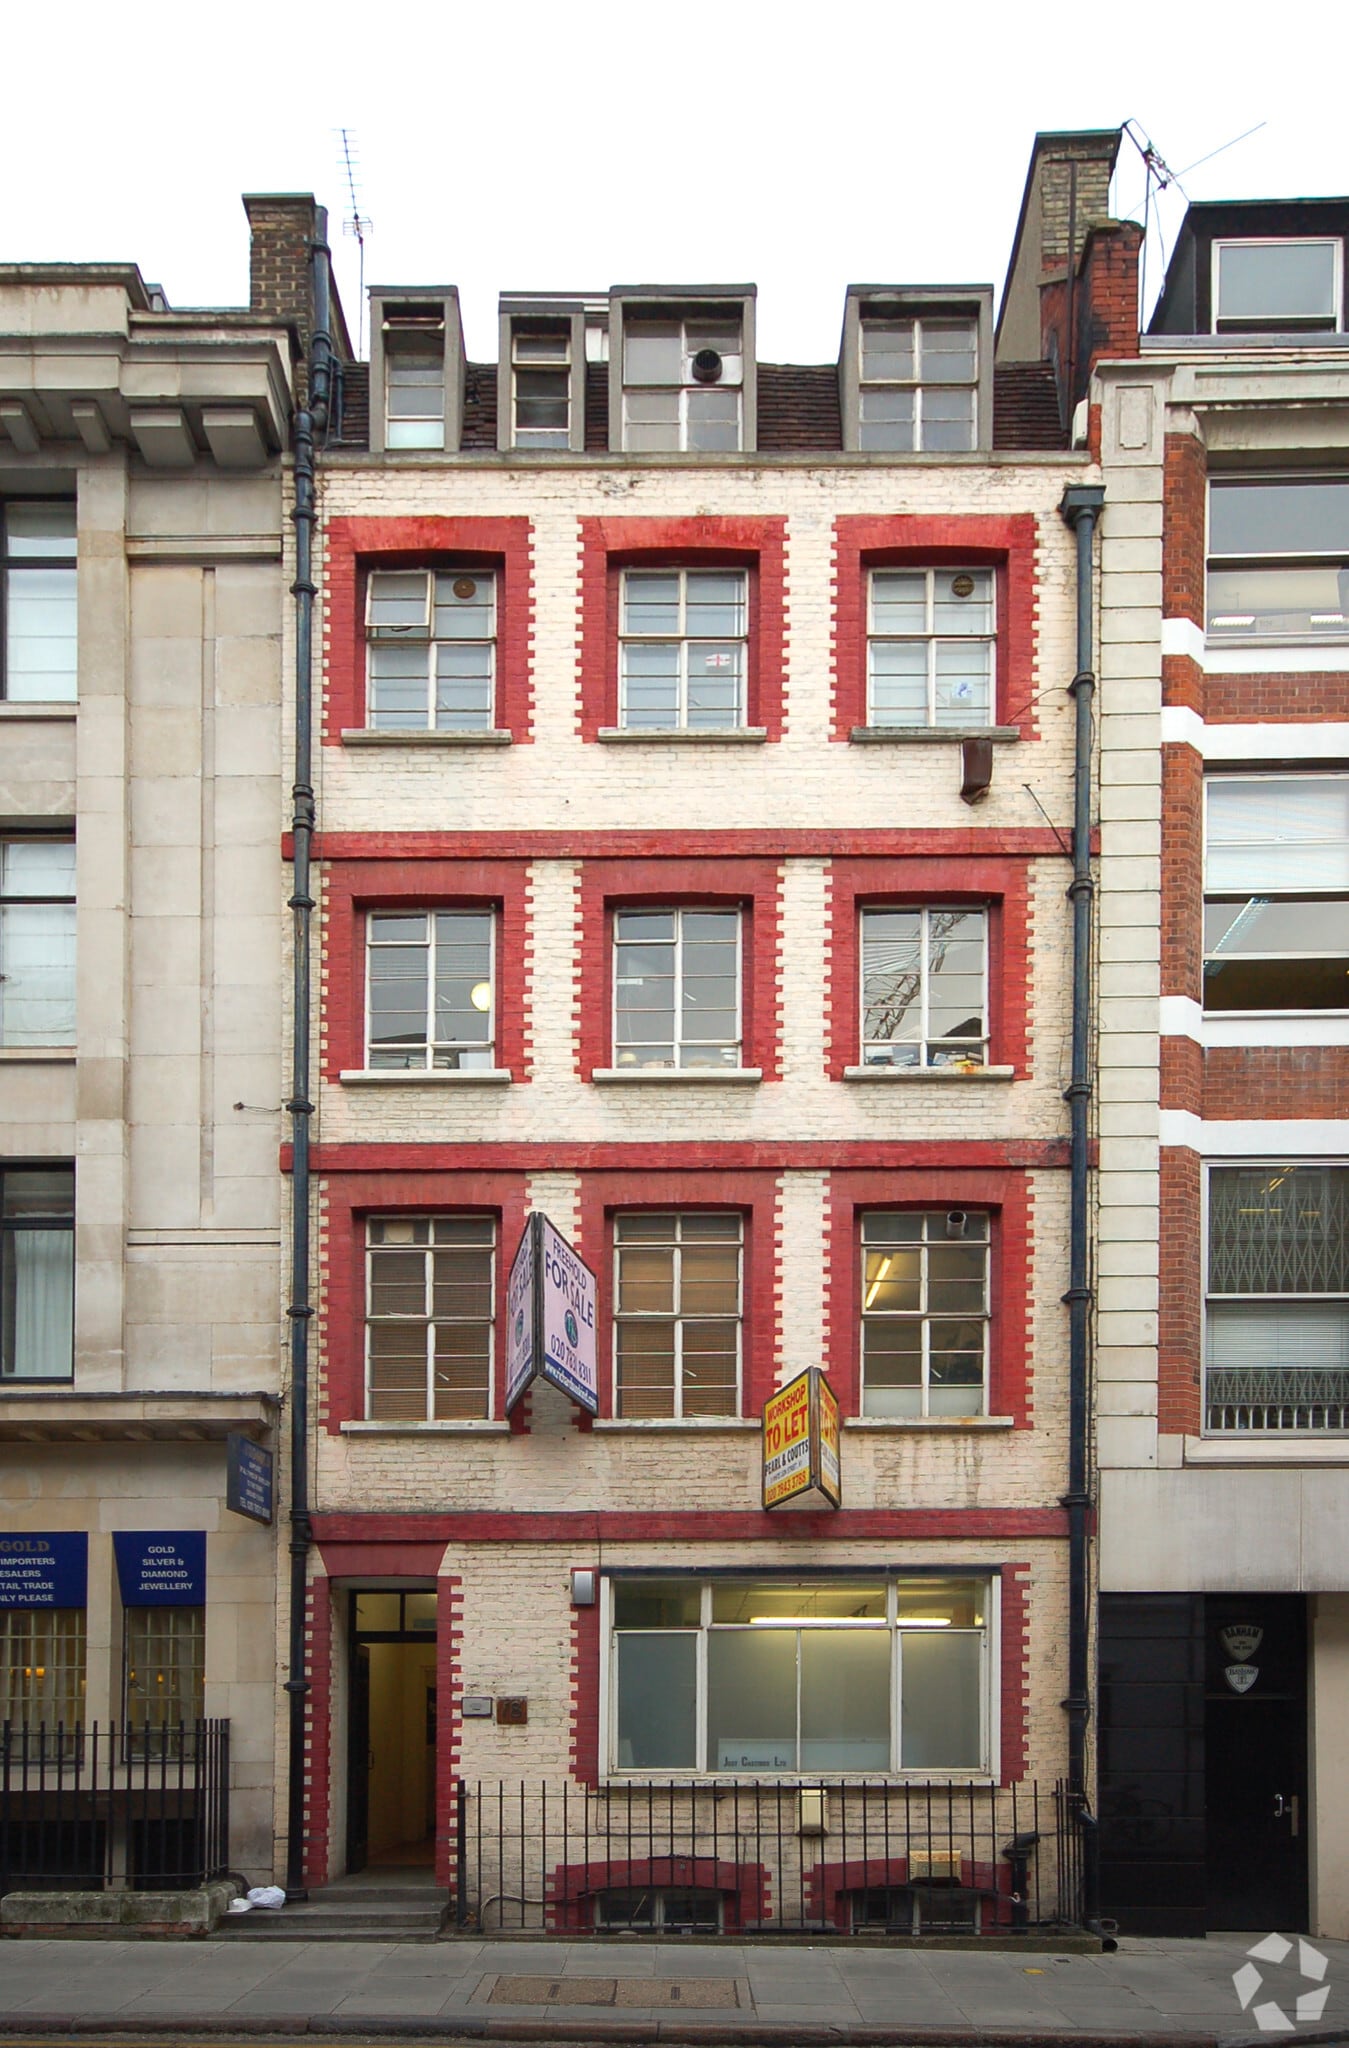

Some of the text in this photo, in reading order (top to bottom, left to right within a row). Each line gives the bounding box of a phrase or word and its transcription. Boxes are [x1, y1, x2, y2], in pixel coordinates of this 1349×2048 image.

[553, 1238, 586, 1290] FREEHOLD
[546, 1252, 568, 1299] FOR
[570, 1282, 594, 1328] SALE
[551, 1334, 566, 1360] 020
[768, 1384, 806, 1424] WORKSHOP
[766, 1404, 808, 1454] TO LET
[0, 1540, 50, 1552] GOLD
[148, 1546, 175, 1554] GOLD
[142, 1558, 184, 1566] SILVER &
[141, 1570, 188, 1578] DIAMOND
[139, 1582, 193, 1591] JEWELLERY
[18, 1594, 54, 1602] PLEASE
